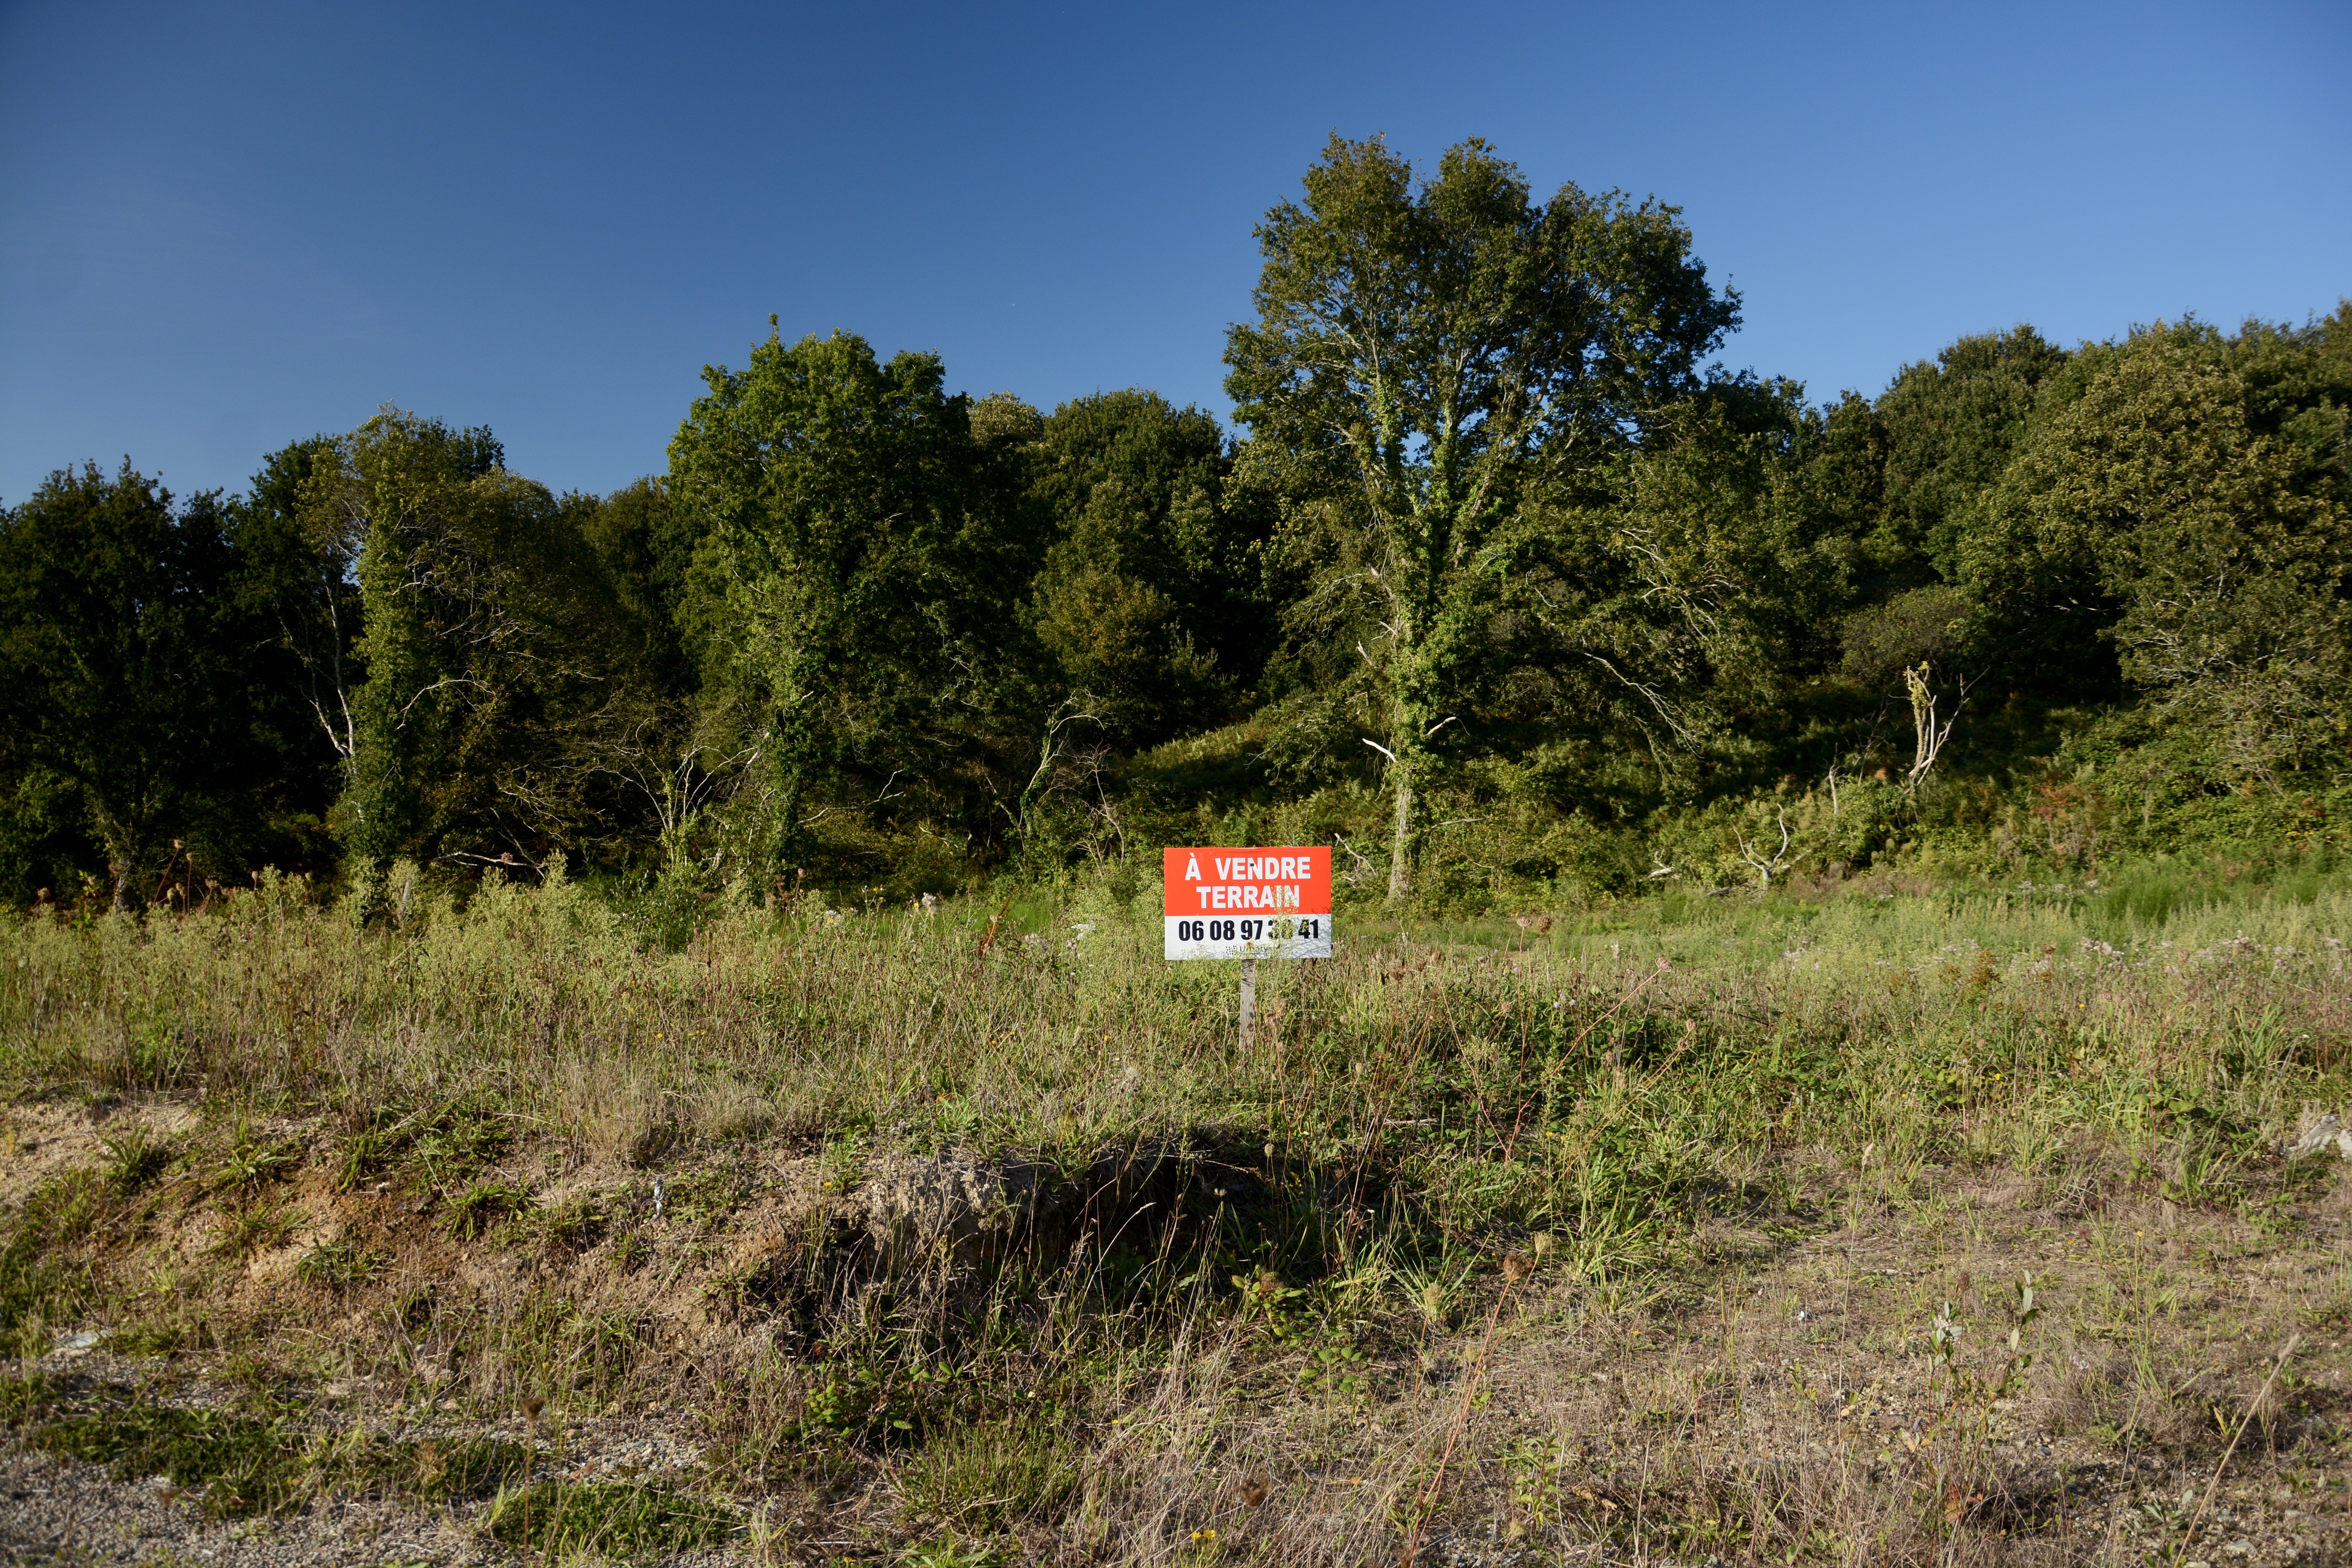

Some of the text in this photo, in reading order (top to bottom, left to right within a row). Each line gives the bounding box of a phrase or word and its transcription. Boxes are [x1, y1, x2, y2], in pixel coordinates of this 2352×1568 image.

[1185, 853, 1311, 880] À VENDRE
[1196, 885, 1299, 909] TERRAIN
[1178, 919, 1319, 941] 06 08 97 3 41
